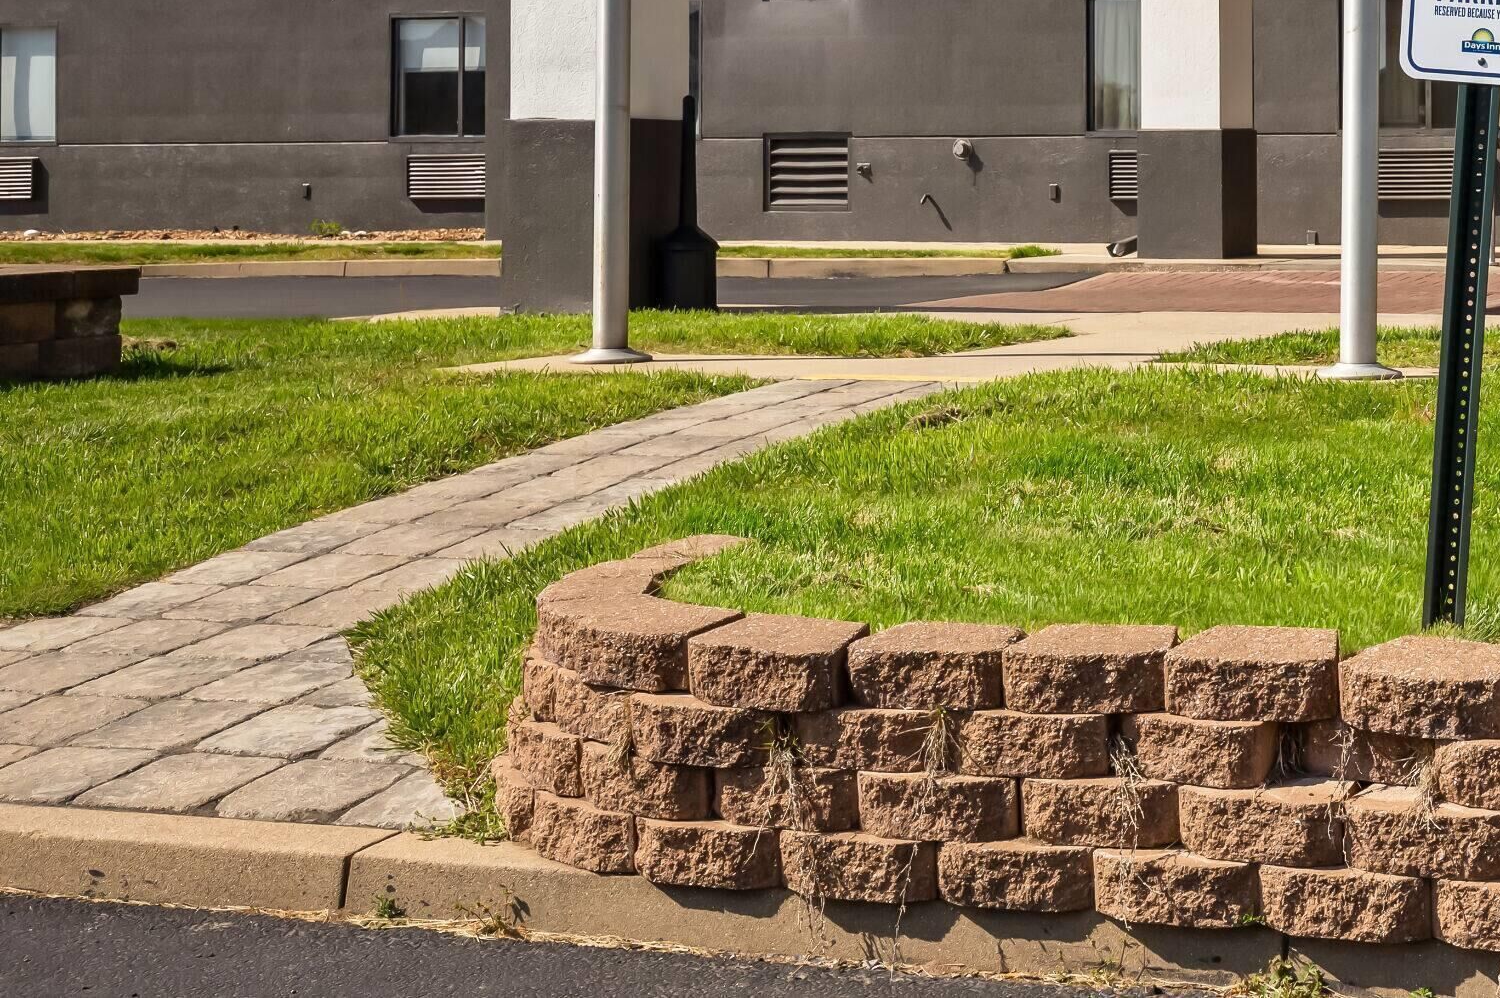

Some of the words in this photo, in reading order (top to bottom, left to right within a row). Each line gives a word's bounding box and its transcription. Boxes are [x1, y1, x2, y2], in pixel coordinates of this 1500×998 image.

[1434, 5, 1466, 17] RESERVED
[1467, 8, 1495, 20] BECAUSE
[1464, 41, 1486, 50] Days
[1486, 43, 1500, 51] Inn
